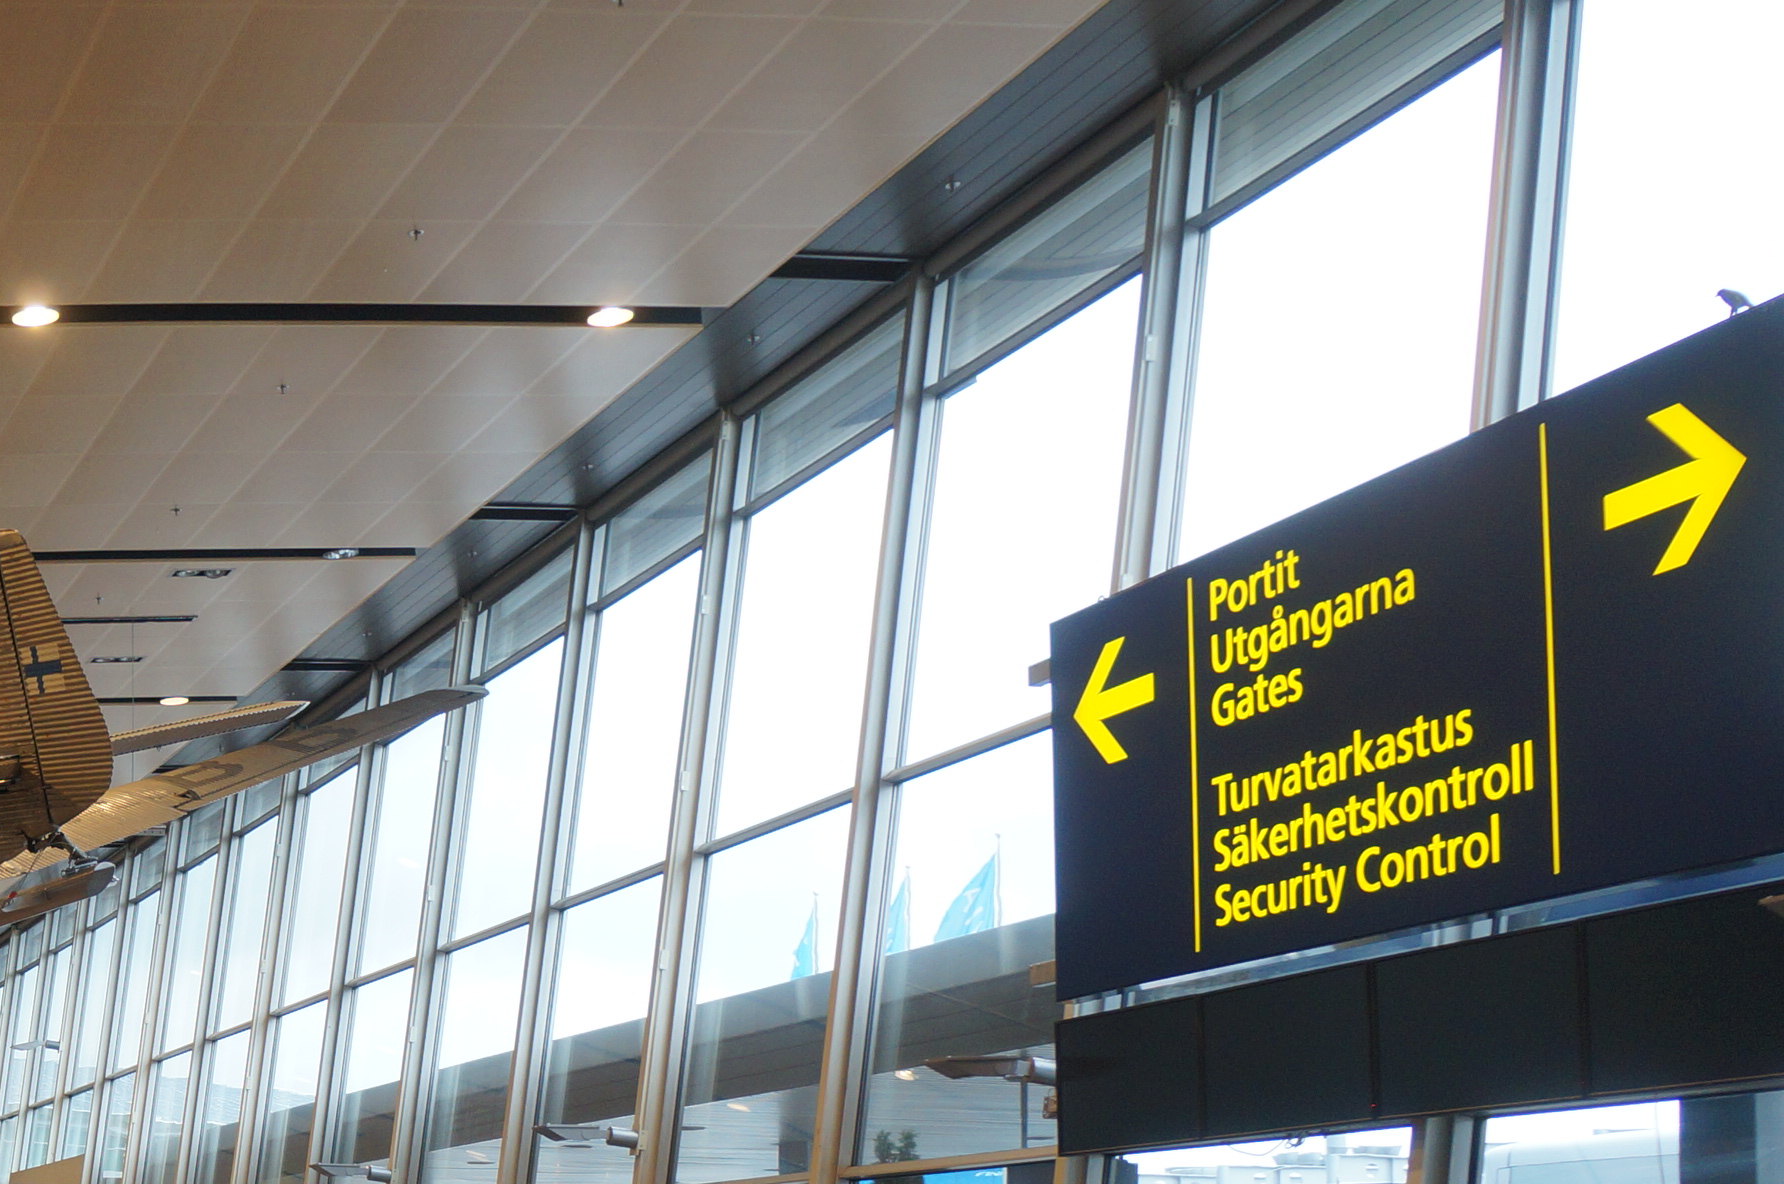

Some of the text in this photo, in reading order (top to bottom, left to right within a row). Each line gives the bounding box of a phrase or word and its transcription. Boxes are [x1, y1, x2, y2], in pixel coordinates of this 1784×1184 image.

[1209, 550, 1301, 621] Portit
[1210, 568, 1416, 674] Utgångarna
[1211, 668, 1304, 727] Gates
[1211, 709, 1474, 816] Turvatarkastus
[1213, 740, 1535, 873] Säkerhetskontroll
[1215, 813, 1501, 927] Security Control
